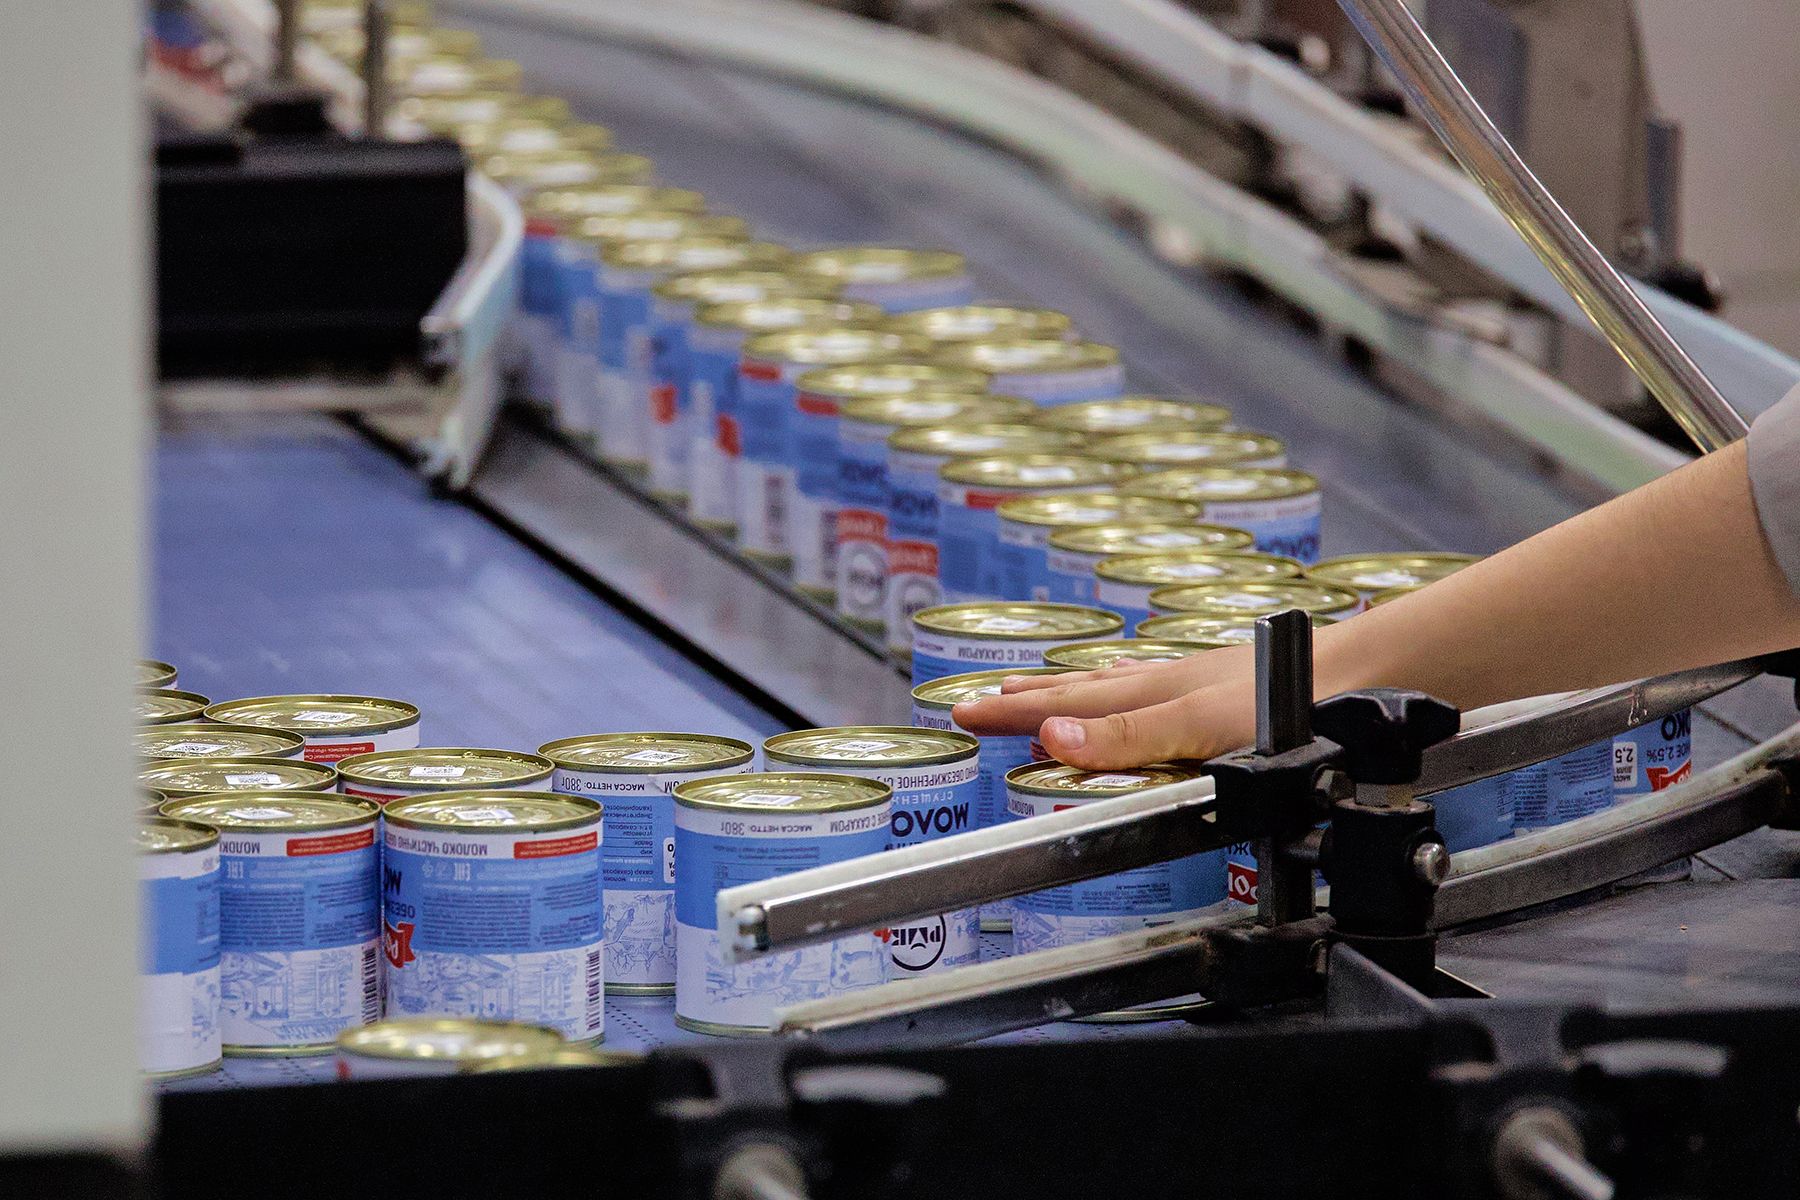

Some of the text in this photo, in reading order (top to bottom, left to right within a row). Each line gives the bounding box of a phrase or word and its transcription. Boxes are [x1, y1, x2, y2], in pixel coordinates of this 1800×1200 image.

[958, 647, 1004, 662] САХАРОМ
[1007, 649, 1015, 662] С
[561, 777, 645, 792] МАССА НЕТТО: 380г
[897, 769, 964, 789] ОБЕЗЖИРЕННОЕ
[721, 821, 745, 836] 380г
[781, 824, 812, 833] МАССА
[829, 816, 870, 833] САХАРОМ
[441, 842, 488, 856] МОЛОКО
